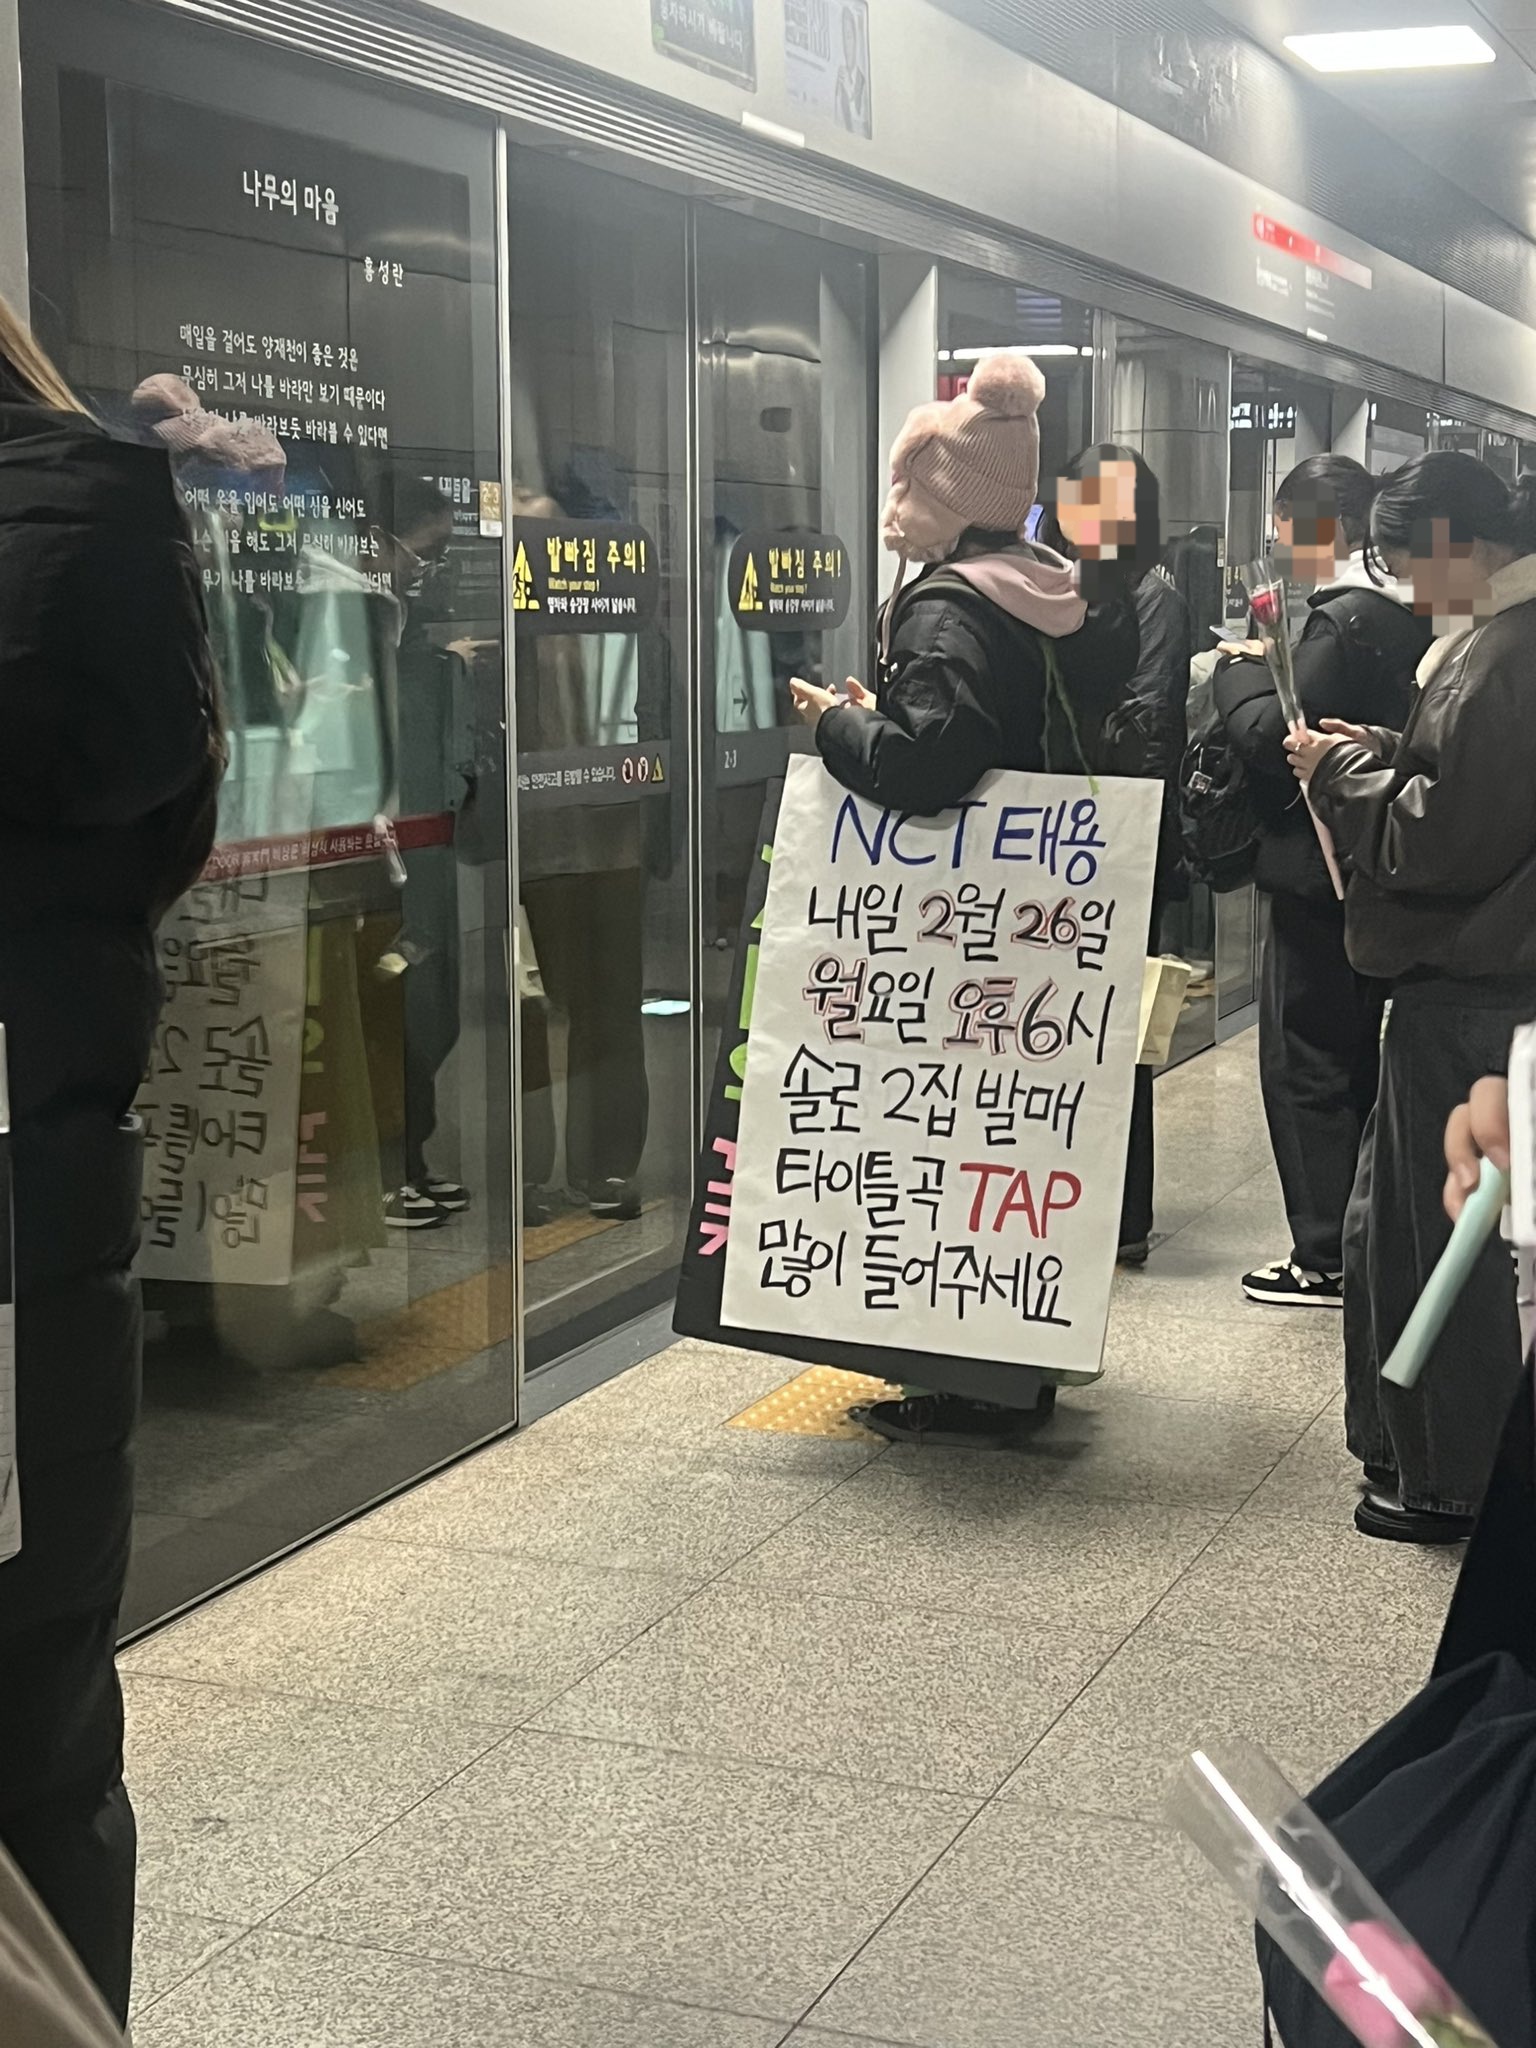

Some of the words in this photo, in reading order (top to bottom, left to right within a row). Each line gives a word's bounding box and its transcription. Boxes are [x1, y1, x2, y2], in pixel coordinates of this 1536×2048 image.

[243, 170, 297, 216] 나무의
[304, 184, 339, 226] 마음
[222, 330, 257, 355] 걸어도
[261, 336, 307, 363] 양재천이
[312, 342, 334, 367] 좋은
[338, 347, 359, 372] 것은
[182, 364, 218, 391] 무심히
[223, 371, 247, 395] 그저
[251, 373, 275, 399] 나를
[279, 377, 314, 404] 바라만
[319, 383, 340, 405] 보기
[343, 385, 385, 411] 때문이다
[306, 419, 338, 445] 바라볼
[343, 421, 354, 442] 수
[357, 424, 388, 450] 있다면
[185, 488, 209, 512] 어떤
[244, 492, 278, 514] 입어도
[283, 493, 305, 518] 어떤
[335, 497, 366, 519] 신어도
[275, 532, 297, 555] 그저
[547, 536, 595, 573] 발빠짐
[607, 539, 645, 574] 주의!
[769, 547, 805, 578] 발빠짐
[231, 569, 255, 594] 나를
[831, 794, 987, 868] NCT
[993, 799, 1107, 886] 태용
[808, 883, 907, 956] 내일
[917, 883, 1006, 963] 2월
[1011, 897, 1116, 971] 26일
[802, 953, 934, 1045] 월요일
[780, 1043, 861, 1135] 솔로
[881, 1063, 963, 1138] 2집
[976, 1068, 1085, 1150] 발매
[960, 1162, 1082, 1239] TAP
[758, 1218, 847, 1298] 많이
[863, 1234, 1072, 1328] 들어주세요
